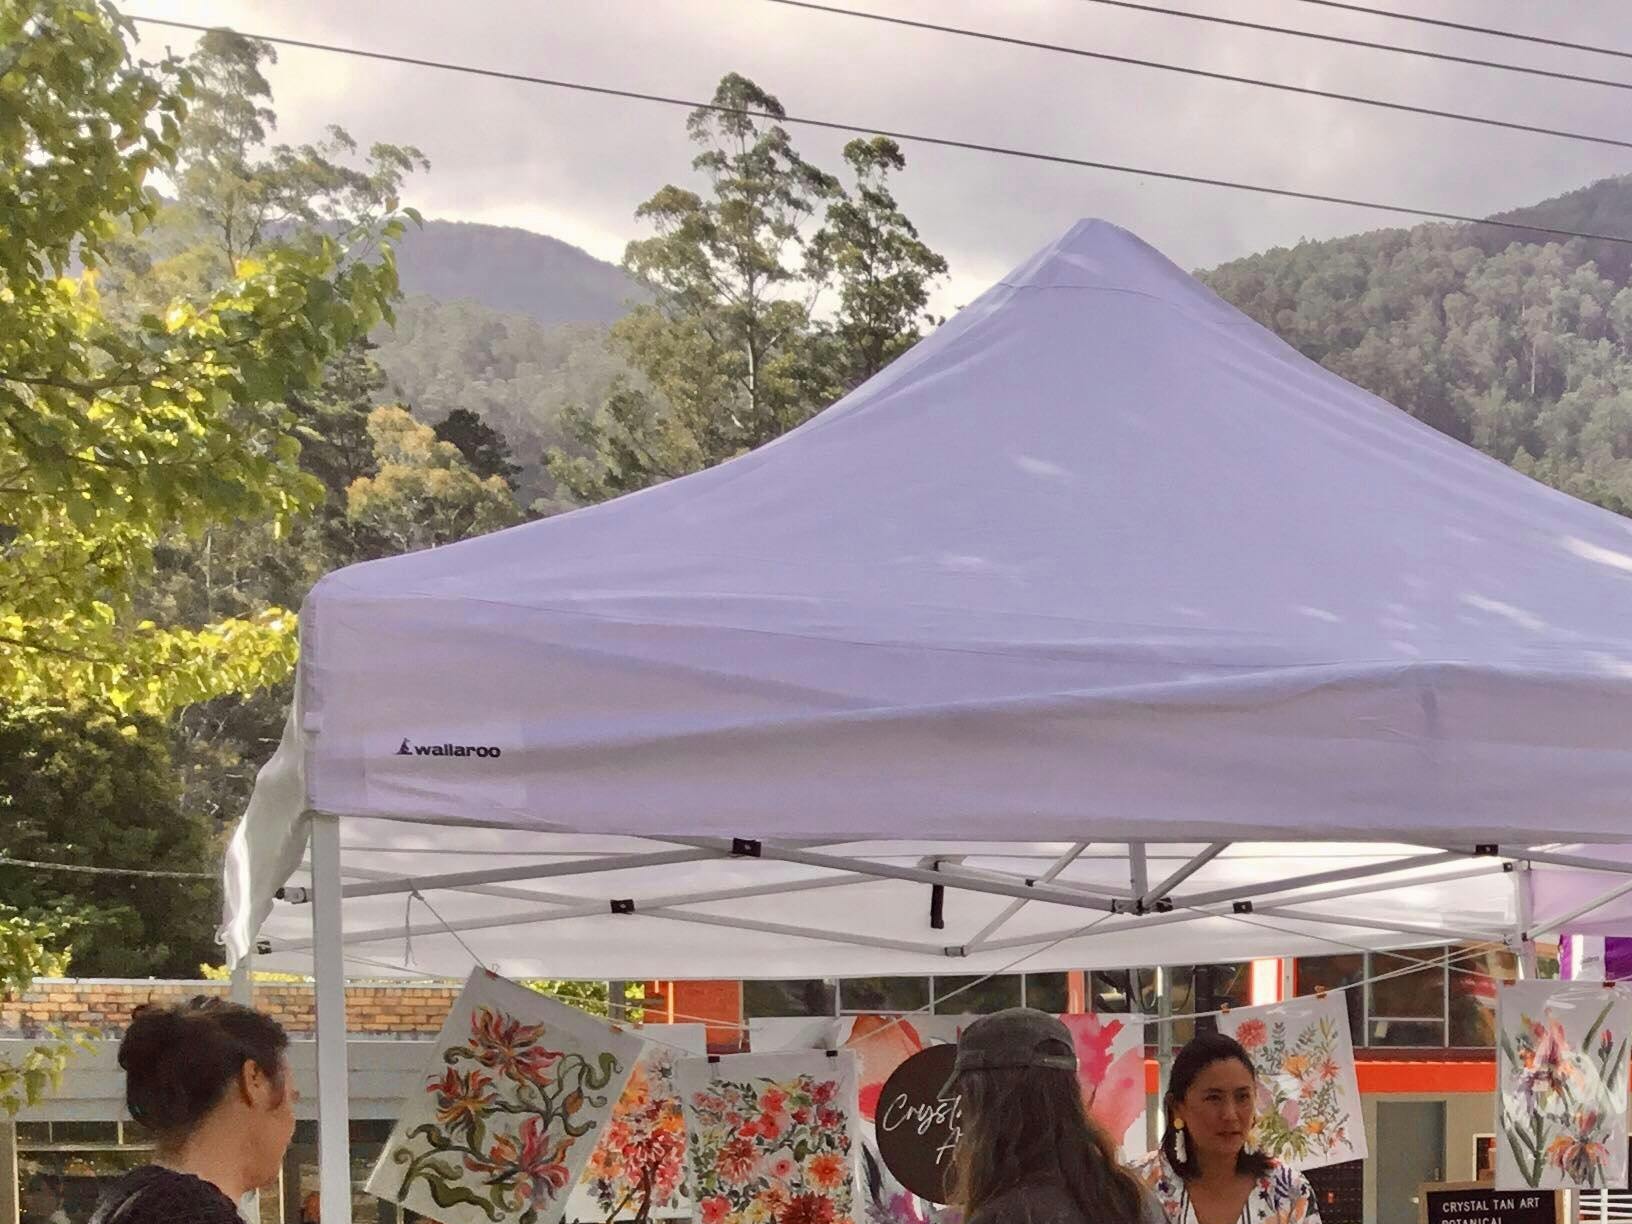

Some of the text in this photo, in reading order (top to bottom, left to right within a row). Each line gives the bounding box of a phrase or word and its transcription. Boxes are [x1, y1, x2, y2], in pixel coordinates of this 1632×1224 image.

[414, 743, 501, 758] wallaroo
[883, 1093, 962, 1135] Cryst
[1442, 1197, 1541, 1213] CRYSTAL TAN ART
